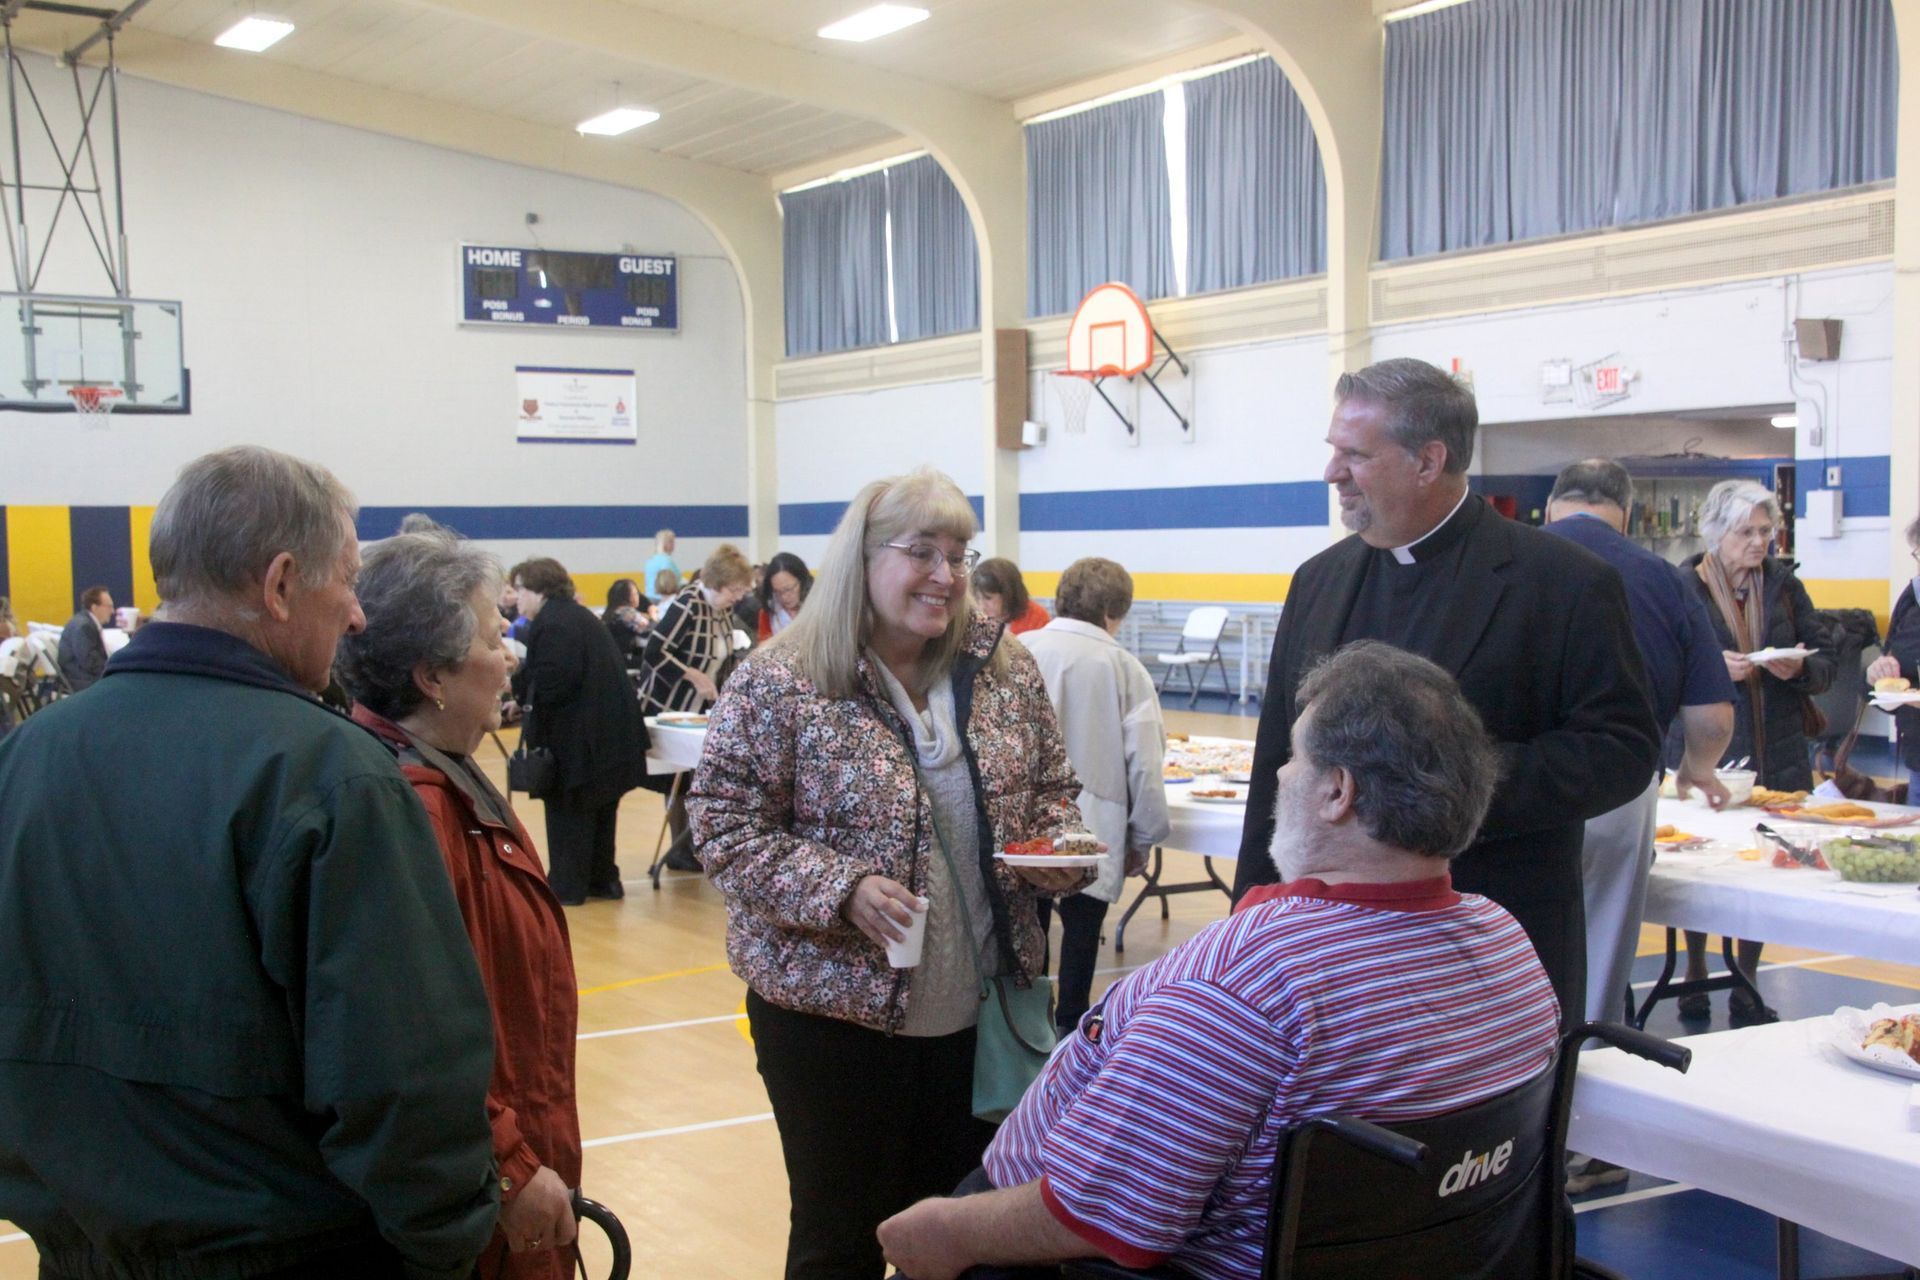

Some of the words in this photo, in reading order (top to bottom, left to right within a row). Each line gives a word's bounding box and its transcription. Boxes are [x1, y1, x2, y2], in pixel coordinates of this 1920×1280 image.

[467, 248, 522, 267] HOME
[619, 257, 674, 275] GUEST
[491, 311, 525, 321] BONUS
[557, 315, 590, 326] PERIOD
[621, 316, 652, 326] BONUS
[1596, 368, 1619, 392] EXIT
[1438, 1139, 1513, 1198] drive
